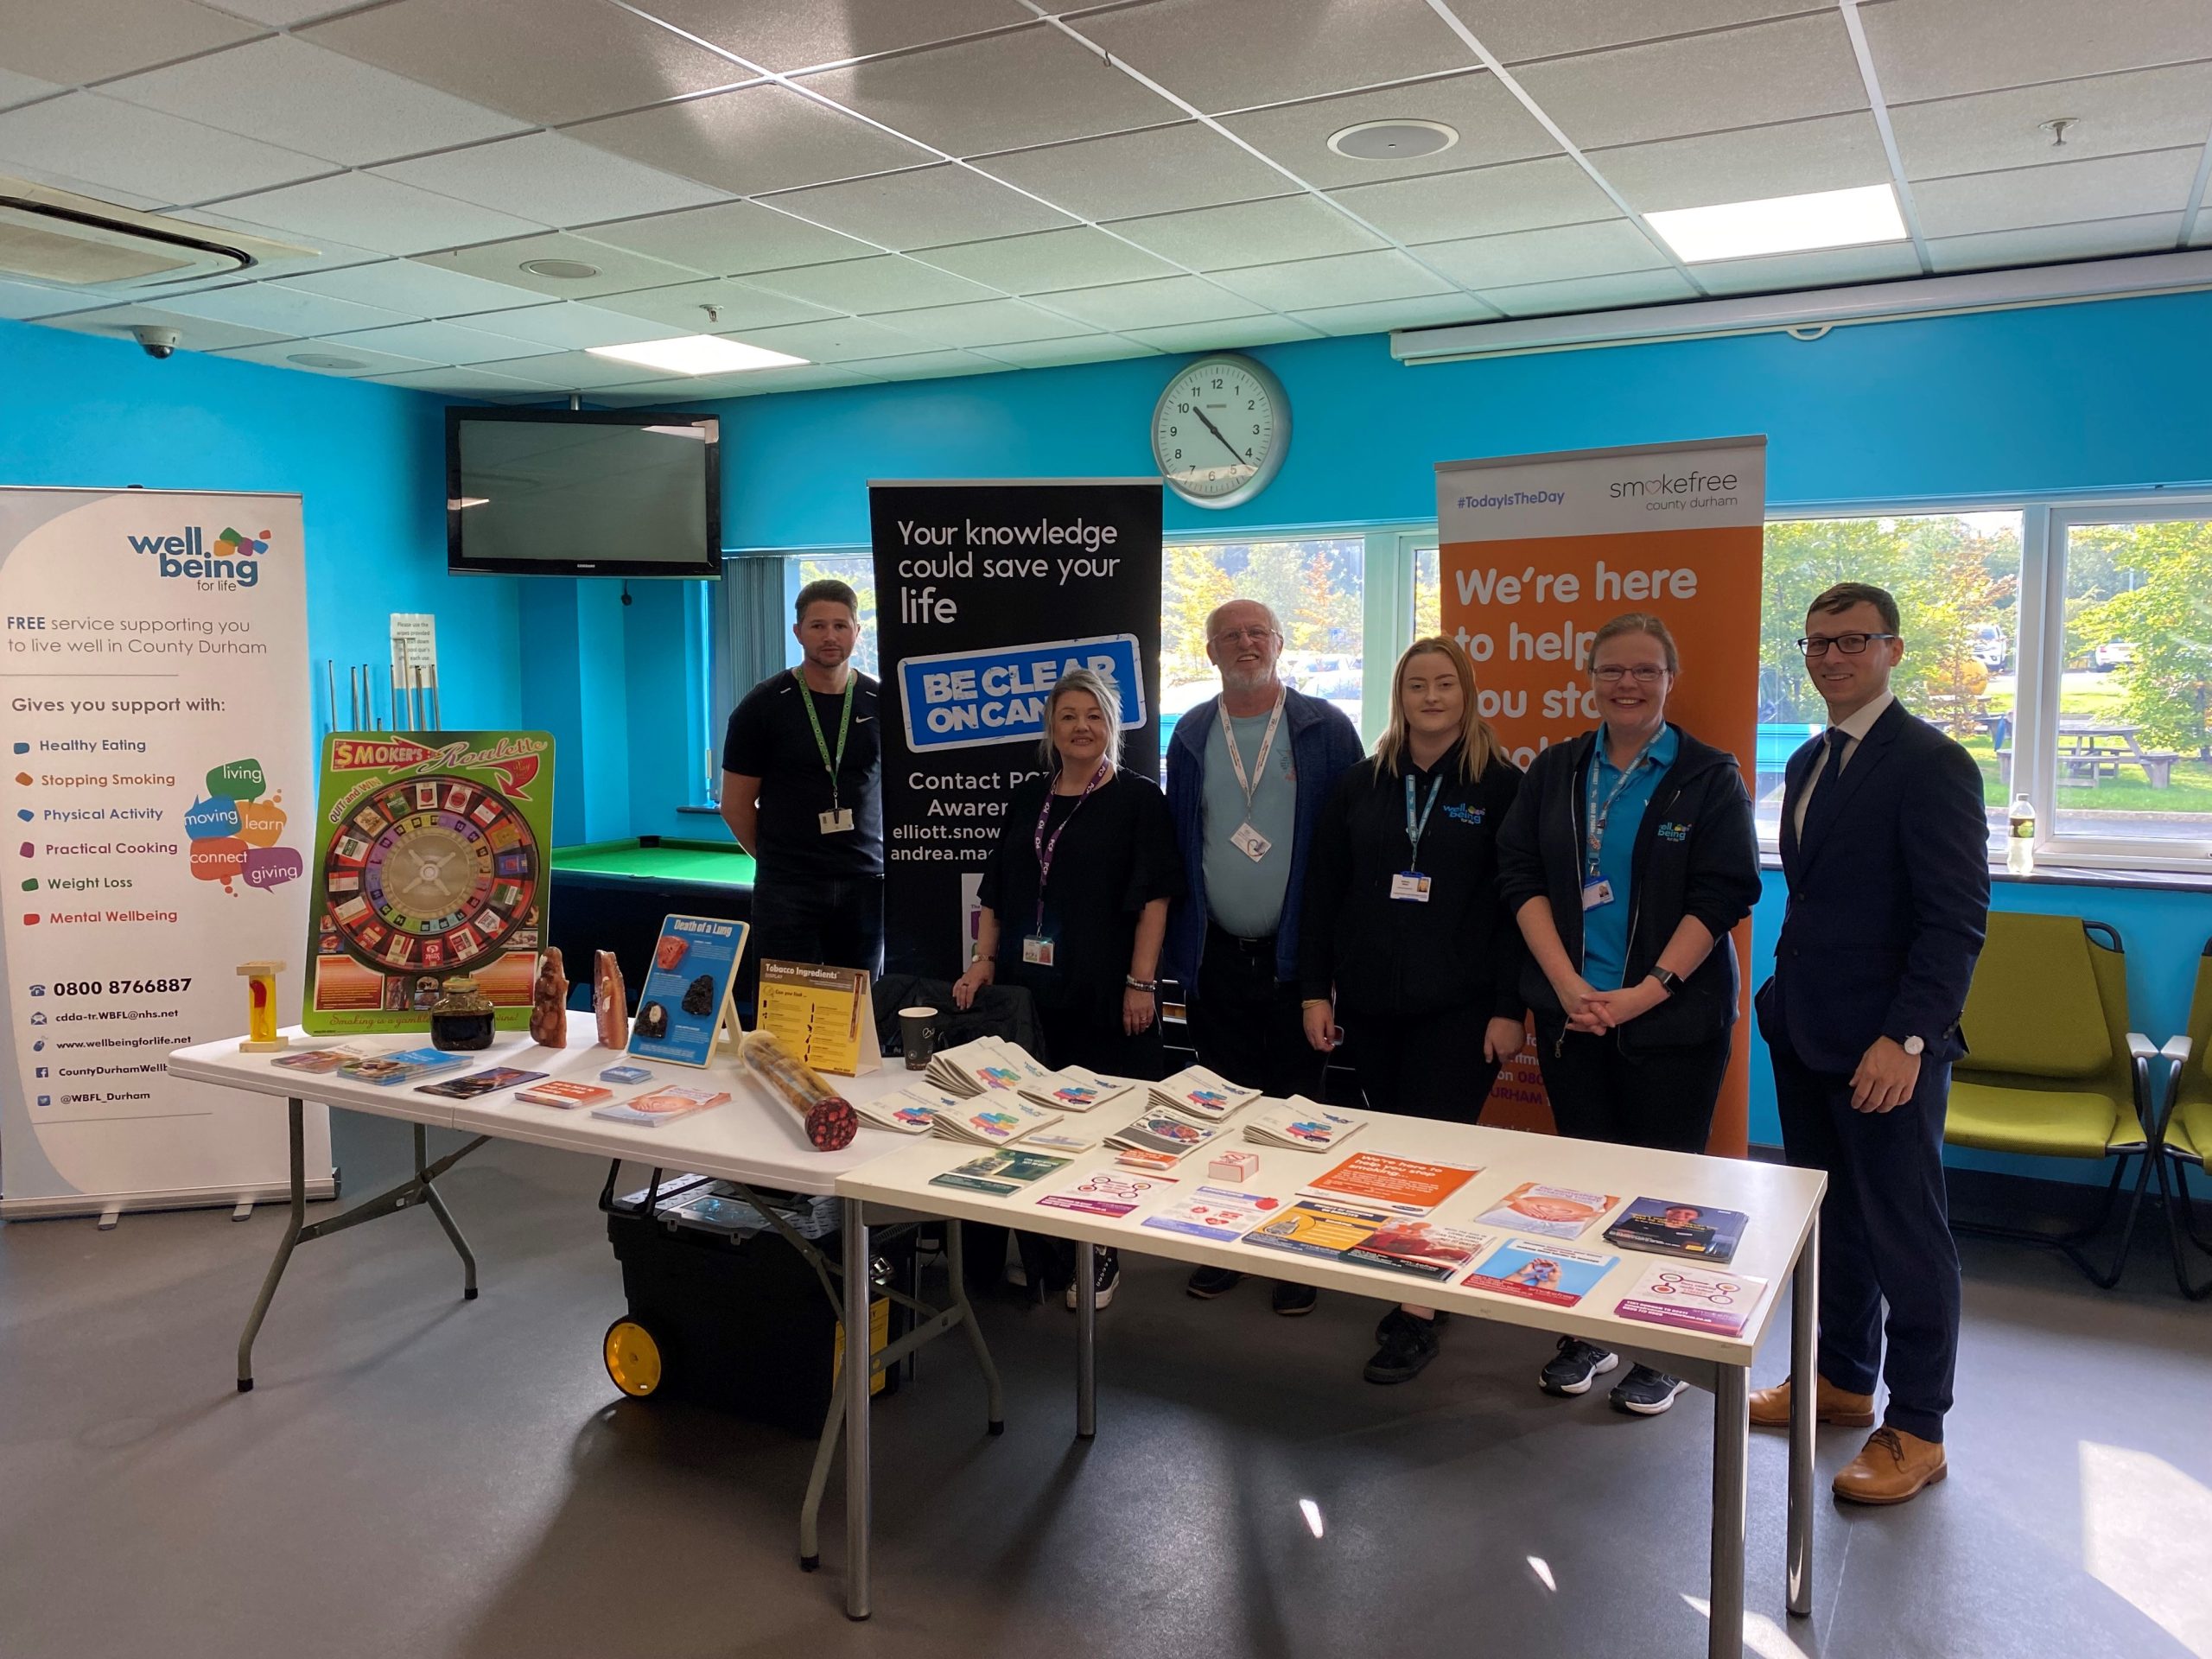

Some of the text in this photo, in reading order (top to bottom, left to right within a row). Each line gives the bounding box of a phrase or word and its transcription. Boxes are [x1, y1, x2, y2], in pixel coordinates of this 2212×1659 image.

[1191, 386, 1201, 397] 11
[1211, 378, 1223, 390] 12
[1234, 385, 1240, 396] 1
[1178, 403, 1190, 414] 10
[1247, 400, 1255, 410] 2
[1170, 426, 1178, 436] 9
[1252, 424, 1260, 435] 3
[1174, 448, 1182, 459] 8
[1245, 448, 1253, 458] 4
[1189, 465, 1196, 475] 7
[1208, 470, 1216, 481] 6
[1230, 464, 1237, 474] 5
[1458, 489, 1566, 510] #TodayIsTheDay
[1645, 495, 1738, 512] county durham
[127, 525, 203, 556] well
[897, 517, 1117, 553] Your knowledge
[159, 551, 258, 588] being
[898, 551, 1121, 586] could save your
[197, 580, 238, 592] for life
[1455, 560, 1698, 607] We're here
[900, 586, 958, 624] life
[7, 616, 251, 635] FREE service supporting you
[9, 639, 268, 657] to live well in County Durham
[1454, 625, 1495, 662] to
[922, 671, 979, 704] BE
[12, 697, 226, 715] Gives you support with:
[1478, 681, 1605, 720] ou sto
[926, 696, 1046, 734] ON CAN
[39, 739, 147, 754] Healthy Eating
[337, 738, 549, 774] SMOKER'S Roulette
[41, 773, 176, 788] Stopping Smoking
[222, 764, 263, 784] living
[908, 772, 1001, 790] Contact
[359, 777, 383, 792] WIN
[43, 808, 164, 823] Physical Activity
[1442, 803, 1466, 813] well
[184, 809, 238, 827] moving
[245, 814, 284, 831] learn
[1449, 809, 1482, 824] being
[892, 824, 1001, 840] elliott.snow
[1657, 828, 1687, 842] being
[46, 842, 179, 857] Practical Cooking
[190, 849, 249, 864] connect
[251, 863, 298, 884] giving
[47, 877, 133, 891] Weight Loss
[49, 910, 178, 925] Mental Wellbeing
[674, 918, 697, 933] Death
[696, 921, 706, 934] of
[712, 923, 734, 938] Lung
[765, 963, 838, 980] Tobacco Ingredients
[54, 977, 193, 997] 0800 8766887
[55, 1009, 179, 1023] cdda-tr.WBFL@nhs.net
[329, 1013, 374, 1029] Smoking
[56, 1035, 193, 1050] www.wellbeingforlife.net
[59, 1063, 168, 1078] CountyDurhamWellb
[60, 1091, 151, 1105] @WBFL_Durham
[1491, 1087, 1542, 1106] URHAM
